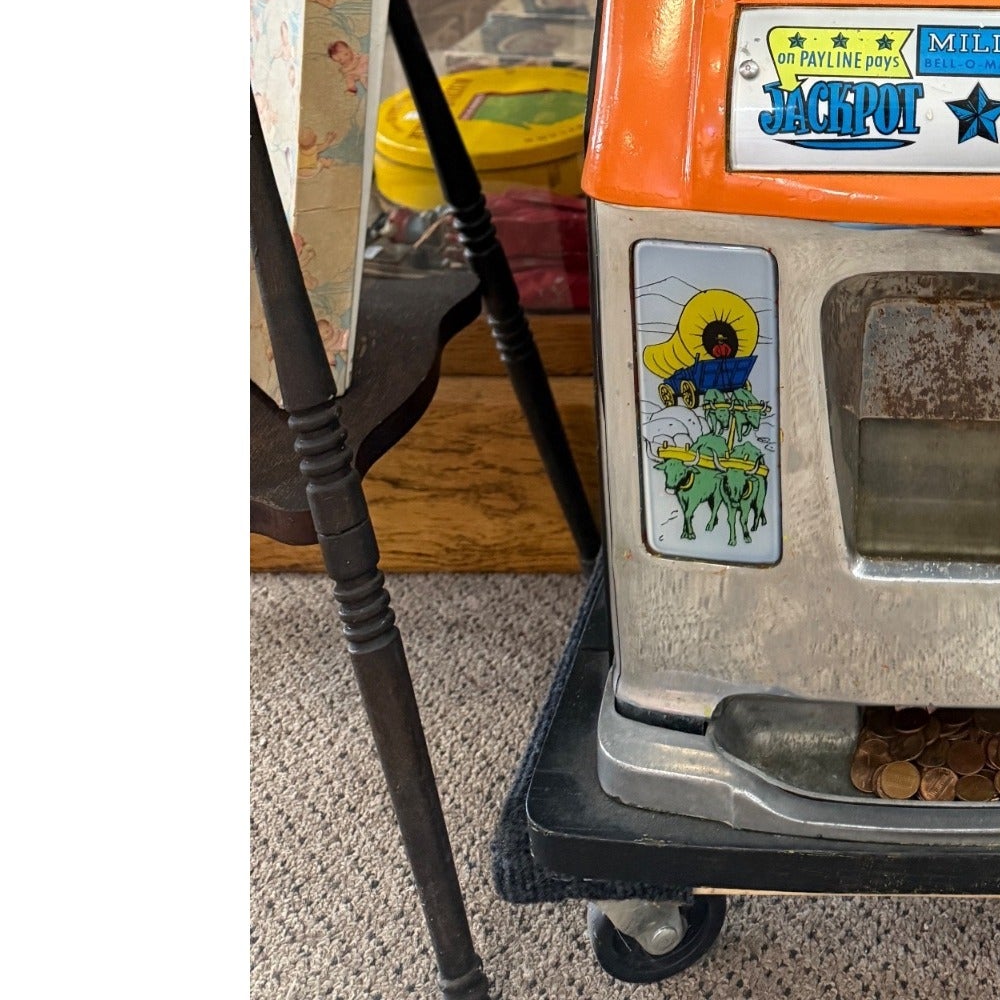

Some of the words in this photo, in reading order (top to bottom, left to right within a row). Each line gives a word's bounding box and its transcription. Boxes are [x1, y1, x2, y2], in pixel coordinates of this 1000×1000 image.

[778, 52, 795, 65] on
[800, 51, 862, 69] PAYLINE
[866, 54, 899, 71] pays
[758, 80, 925, 137] JACKPOT
